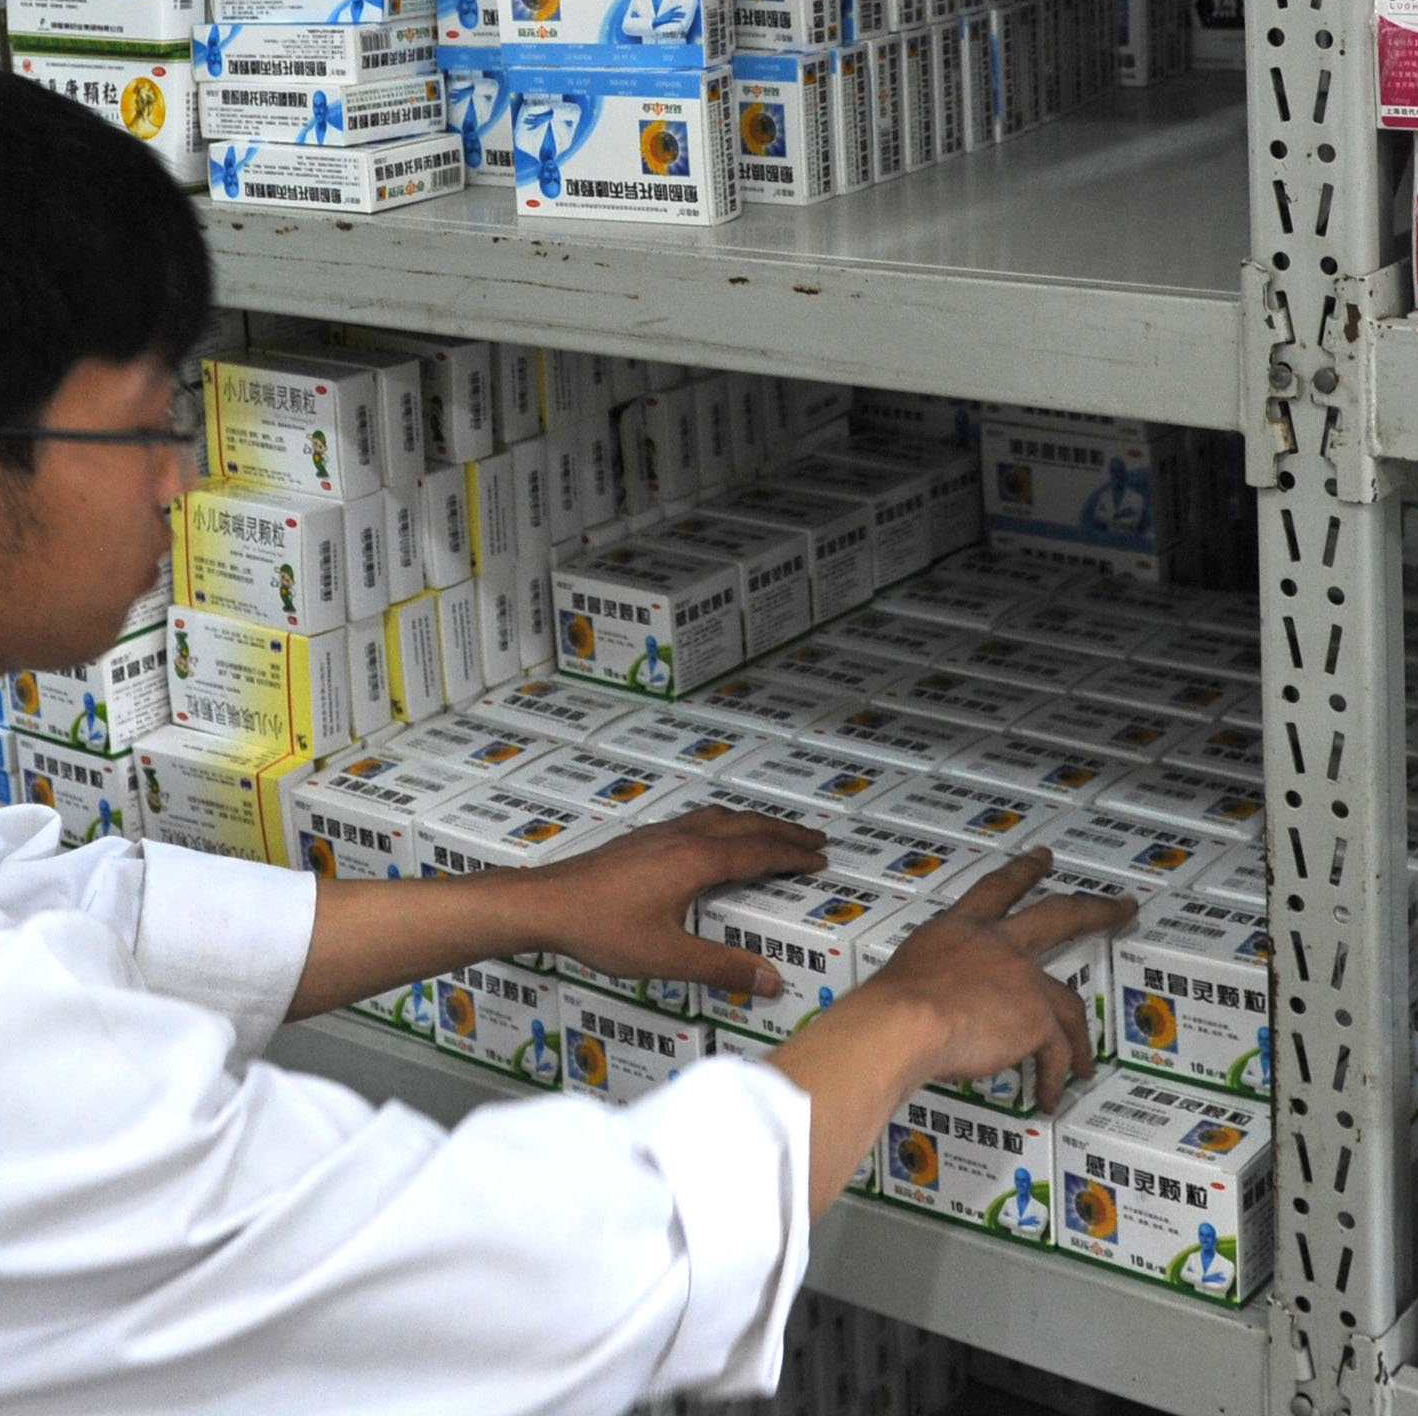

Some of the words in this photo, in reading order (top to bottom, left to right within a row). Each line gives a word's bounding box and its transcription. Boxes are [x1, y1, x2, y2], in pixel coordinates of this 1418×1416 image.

[223, 377, 317, 415] 小儿咳喘灵颗粒
[193, 504, 285, 548] 小儿咳喘灵颗粒
[311, 814, 393, 854] 感冒灵颗粒
[724, 925, 826, 974] 感冒灵颗粒
[1143, 967, 1267, 1015] 感冒灵颗粒
[580, 1011, 676, 1058] 感冒灵颗粒
[908, 1103, 1023, 1155] 感冒灵颗粒
[1128, 1085, 1256, 1126] 感冒灵颗粒
[1085, 1153, 1209, 1210] 感冒灵颗粒
